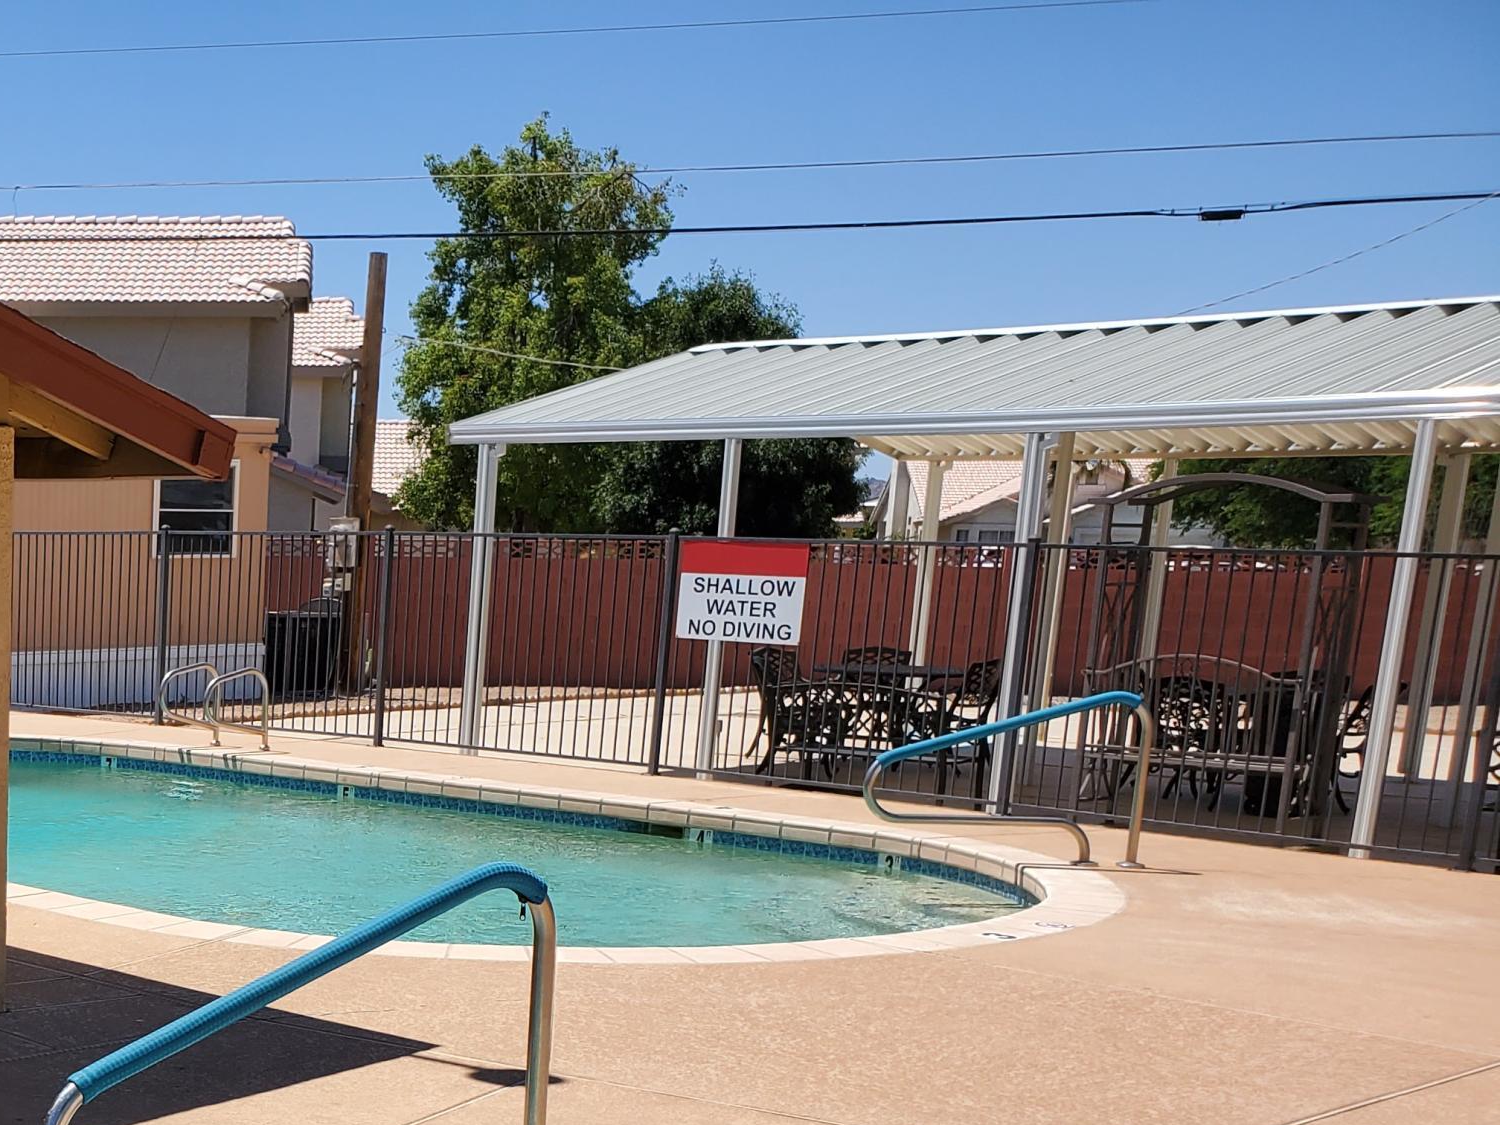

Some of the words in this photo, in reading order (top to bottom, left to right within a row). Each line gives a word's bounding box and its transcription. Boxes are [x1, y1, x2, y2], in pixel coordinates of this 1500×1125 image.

[693, 577, 796, 597] SHALLOW
[706, 599, 777, 618] WATER
[688, 619, 716, 636] NO
[722, 621, 792, 641] DIVING
